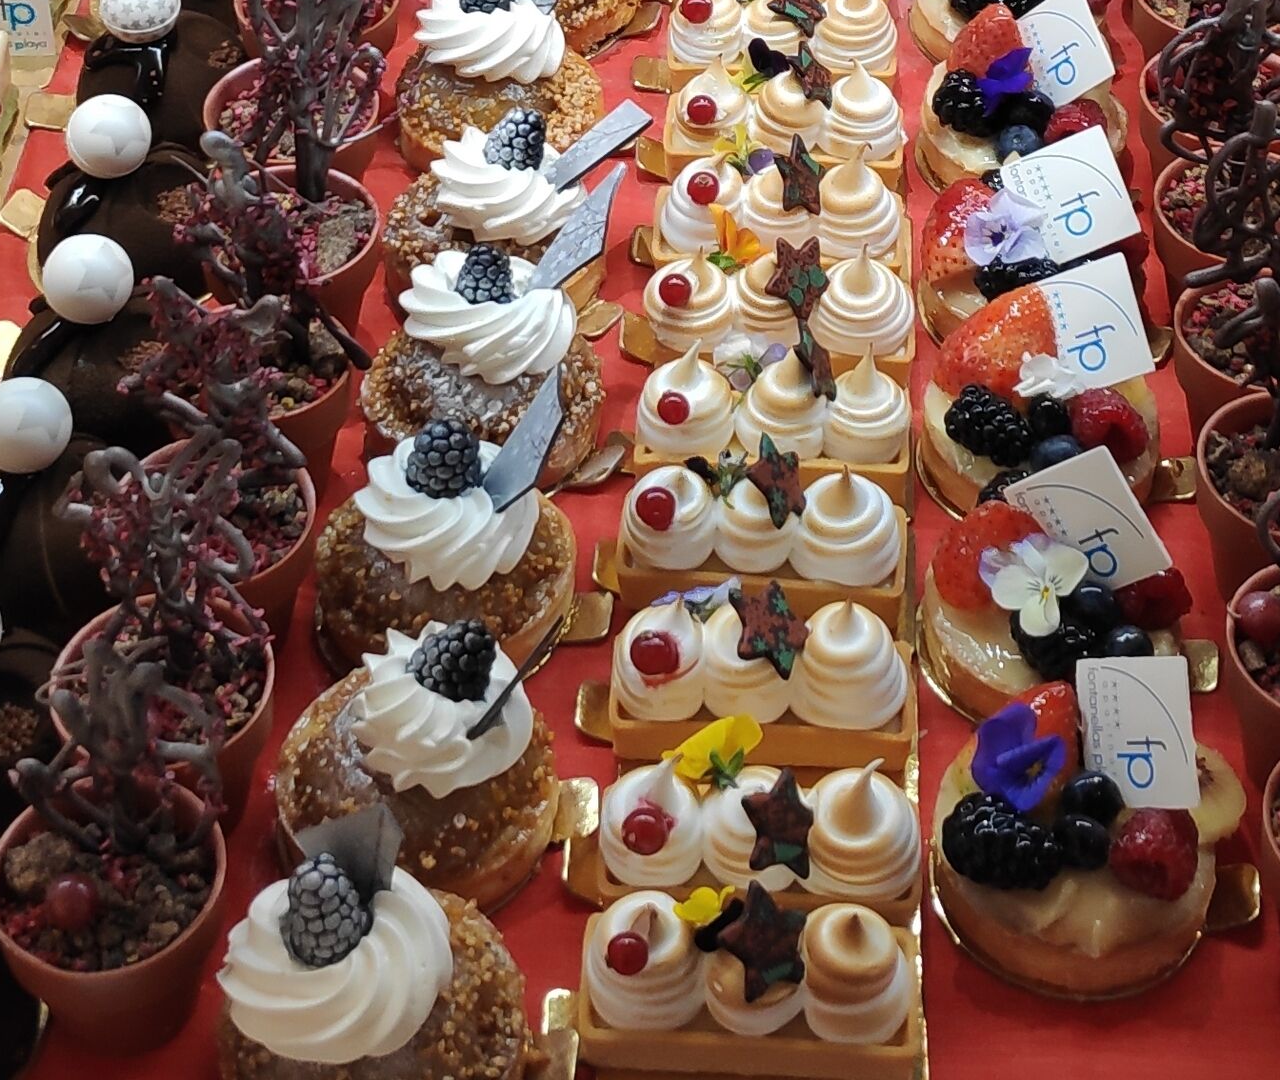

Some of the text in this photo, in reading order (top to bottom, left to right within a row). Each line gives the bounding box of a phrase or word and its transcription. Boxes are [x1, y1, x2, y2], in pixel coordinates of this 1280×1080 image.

[15, 39, 48, 51] playa
[1046, 42, 1079, 85] fp
[1053, 191, 1100, 235] fp
[1067, 325, 1115, 371] fp
[1117, 735, 1167, 789] fp
